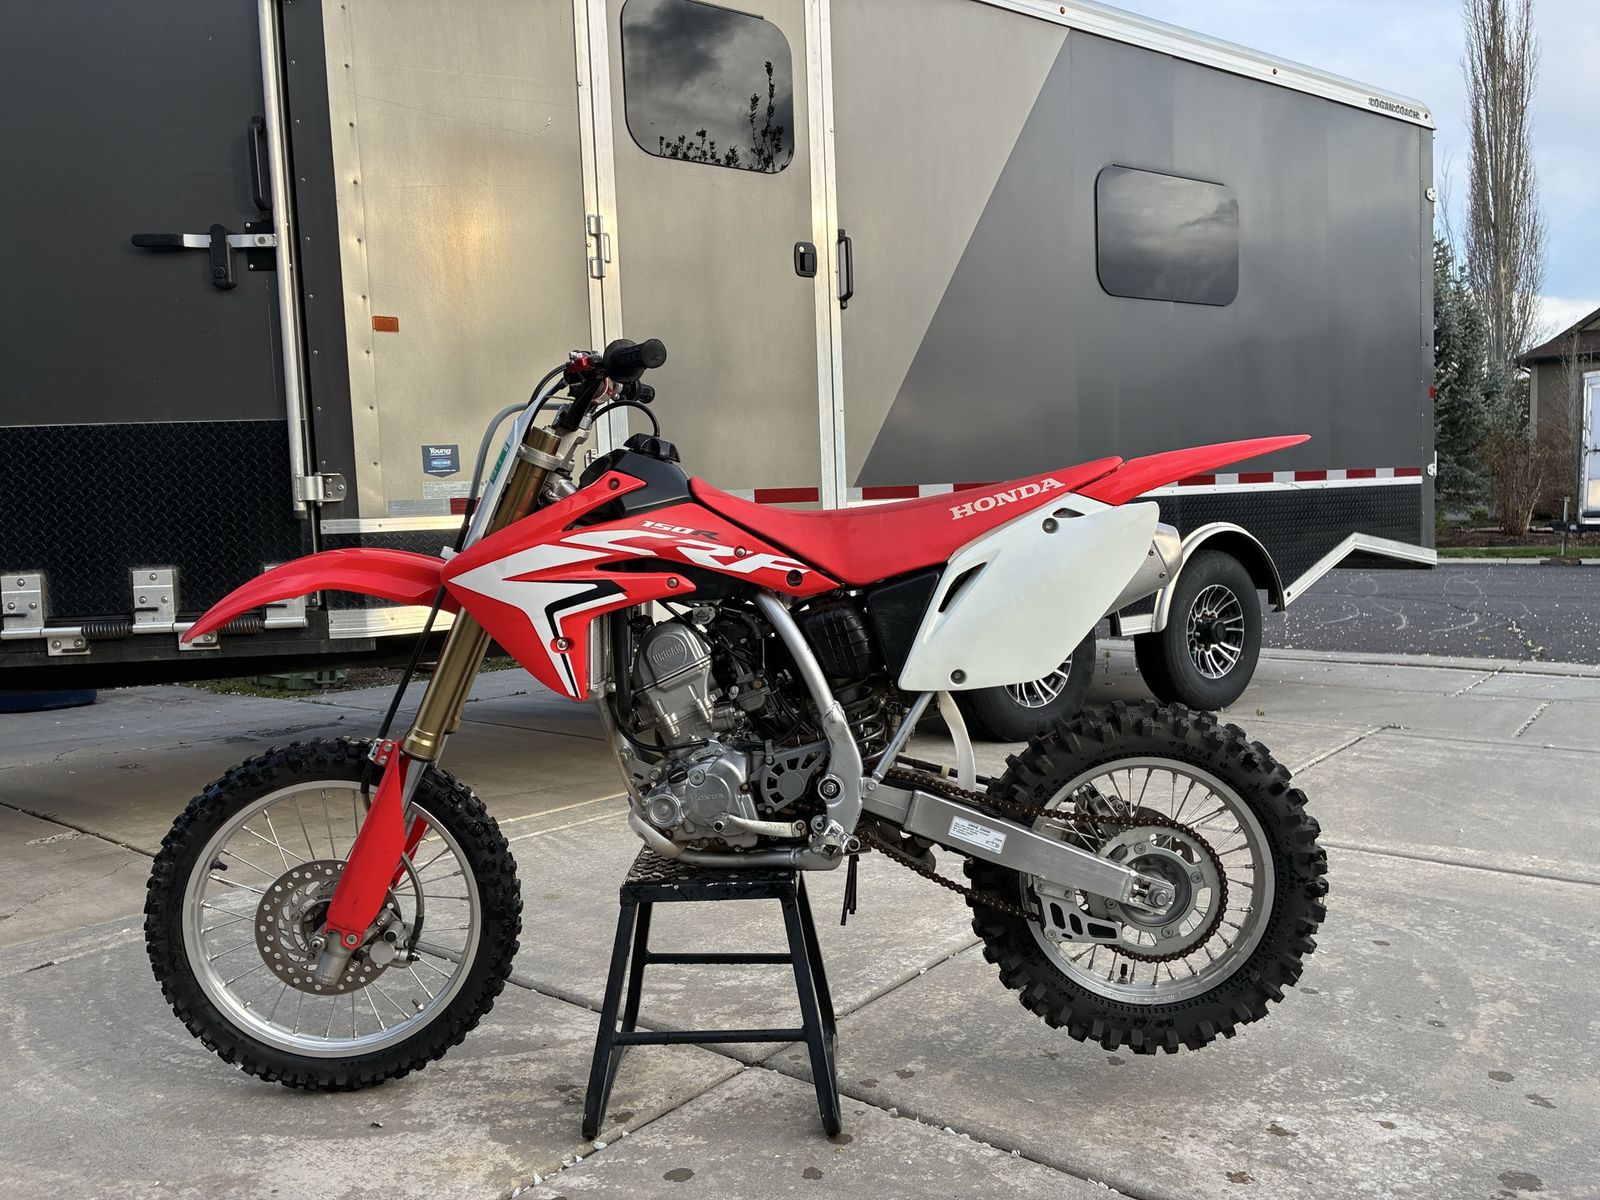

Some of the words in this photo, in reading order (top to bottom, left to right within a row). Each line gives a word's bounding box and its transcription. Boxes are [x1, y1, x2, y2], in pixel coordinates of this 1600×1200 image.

[429, 447, 451, 456] Young
[949, 477, 1066, 520] HONDA
[640, 520, 720, 541] 150R
